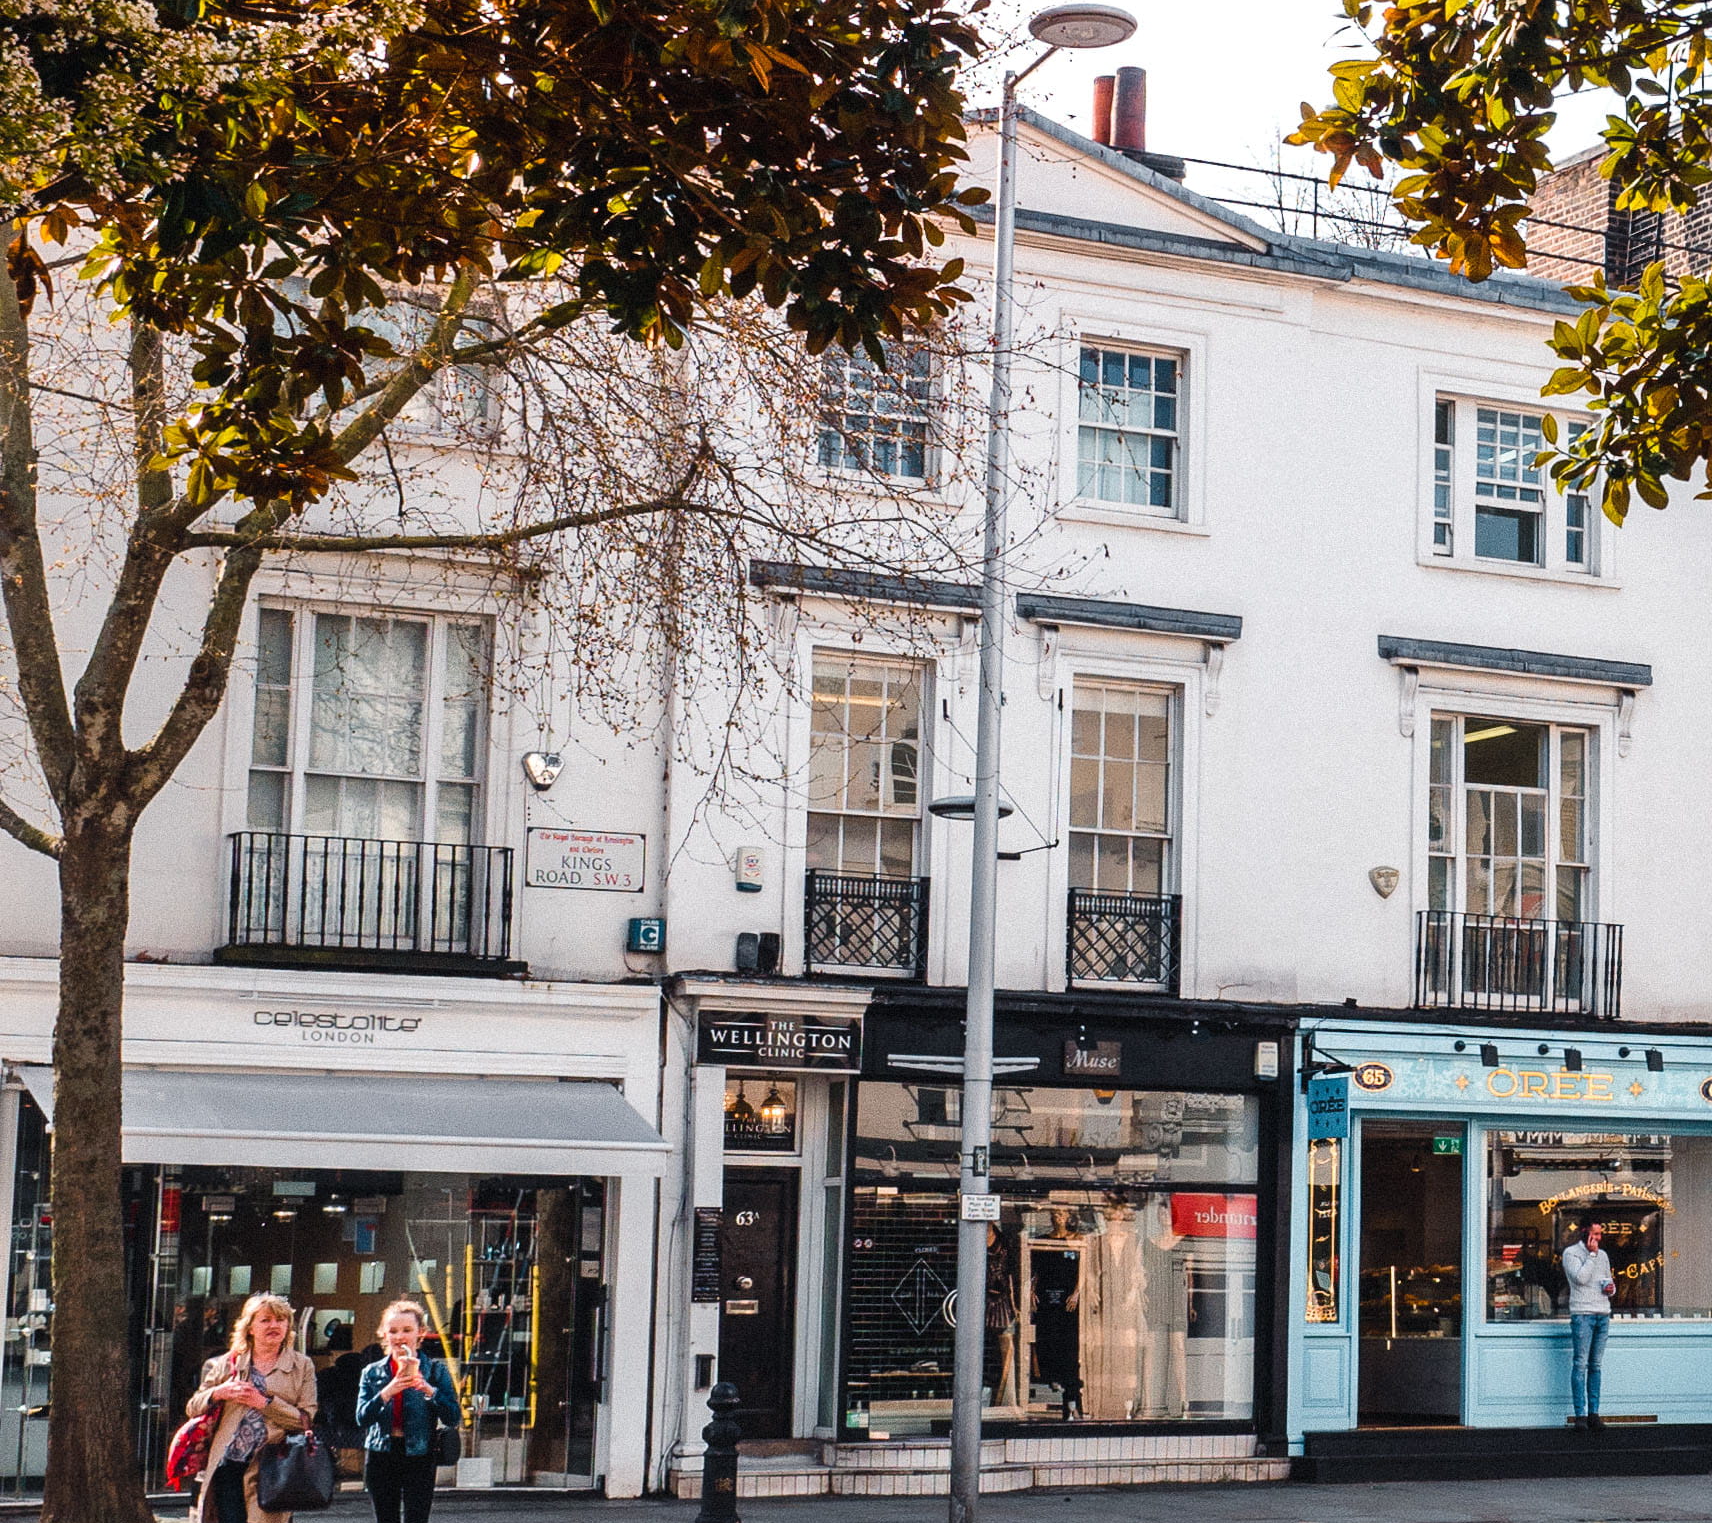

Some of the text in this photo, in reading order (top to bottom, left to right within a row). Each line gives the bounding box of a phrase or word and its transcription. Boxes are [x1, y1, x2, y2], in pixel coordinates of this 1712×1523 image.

[561, 855, 612, 871] KINGS
[770, 1021, 796, 1031] THE
[302, 1030, 374, 1044] LONDON
[710, 1029, 851, 1049] WELLINGTON
[758, 1047, 806, 1058] CLINIC
[1066, 1050, 1118, 1069] Muse
[1362, 1069, 1385, 1085] 65
